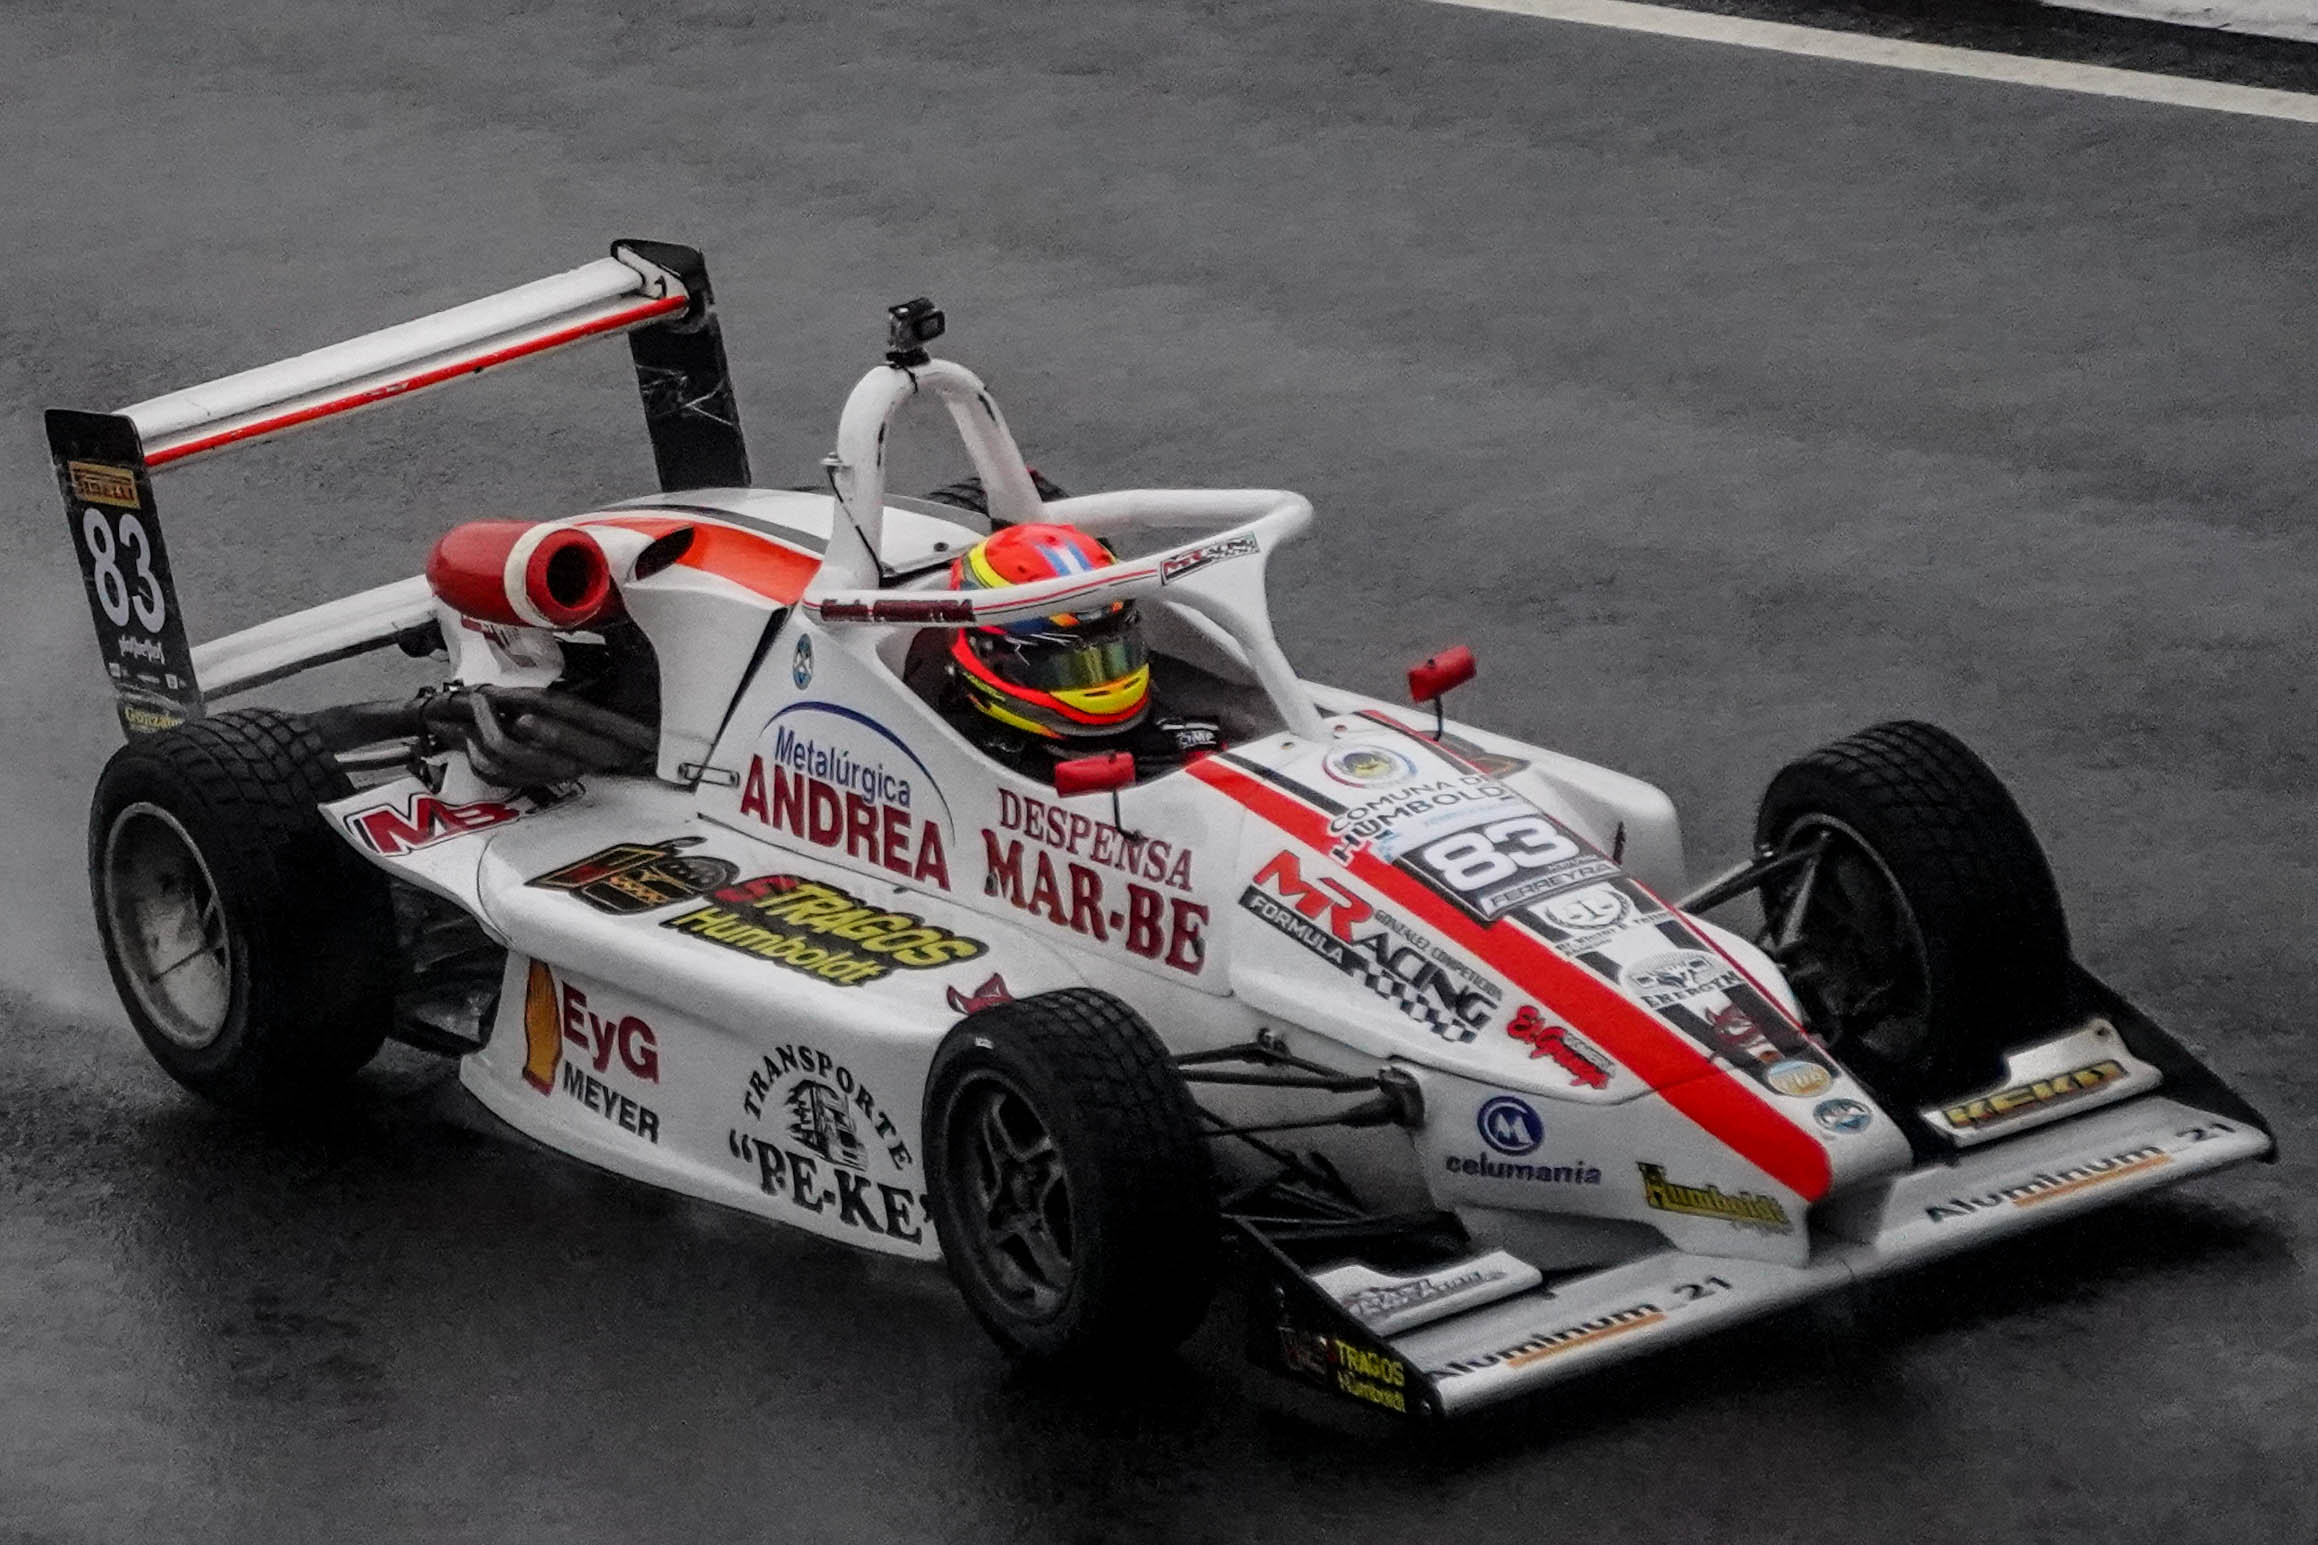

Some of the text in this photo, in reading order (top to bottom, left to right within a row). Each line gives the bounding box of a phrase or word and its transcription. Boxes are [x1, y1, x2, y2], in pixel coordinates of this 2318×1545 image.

[82, 508, 166, 633] 83
[774, 725, 911, 807] Metalúrgica
[1330, 780, 1452, 833] COMUNA
[738, 753, 952, 892] ANDREA
[998, 787, 1194, 892] DESPENSA
[1331, 784, 1515, 866] HUMBOLD
[1423, 816, 1581, 892] 83
[751, 883, 979, 966] TRAGOS
[981, 828, 1211, 975] MAR-BE
[1489, 862, 1613, 907] FERREYRA
[672, 906, 888, 983] Humboldt
[1249, 893, 1345, 965] FORMULA
[561, 980, 660, 1085] EyG
[562, 1059, 660, 1145] MEYER
[743, 1044, 913, 1171] TRANSPORTE
[1925, 1122, 2236, 1223] Aluminum 21
[1672, 1276, 1733, 1301] 21
